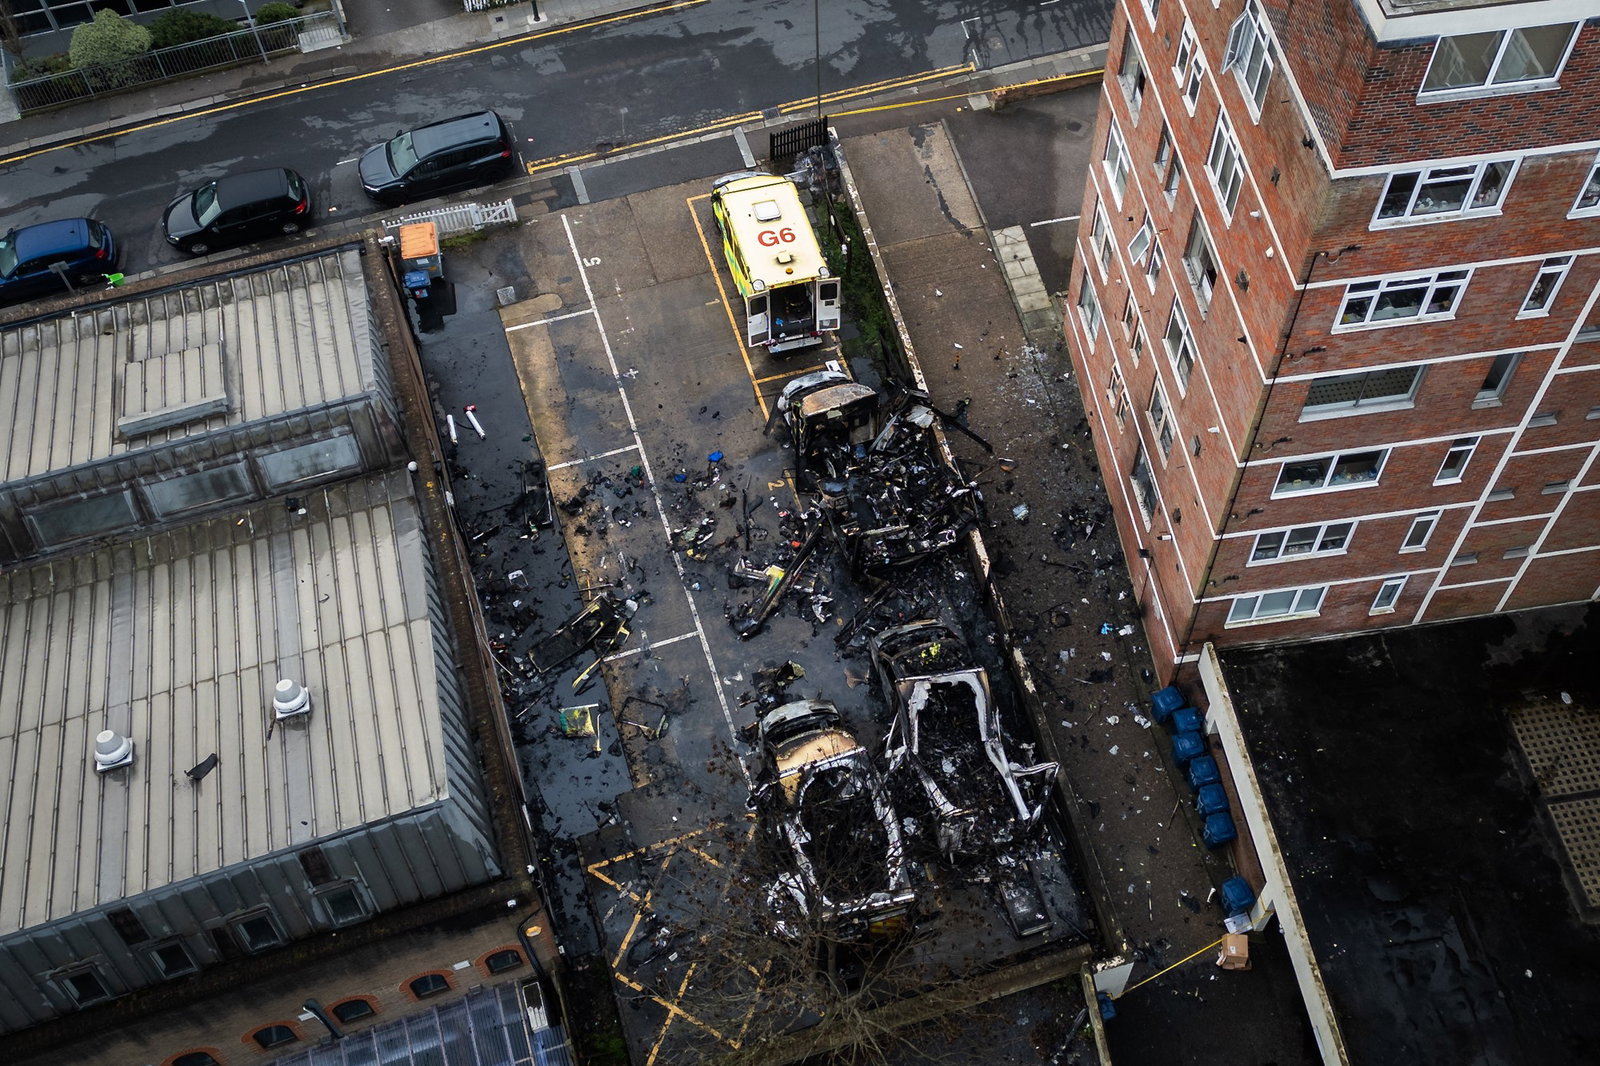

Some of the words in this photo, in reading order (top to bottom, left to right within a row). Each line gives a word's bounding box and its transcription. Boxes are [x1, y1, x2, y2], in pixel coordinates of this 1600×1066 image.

[757, 228, 796, 247] G6
[583, 257, 601, 267] 5
[768, 480, 785, 491] 2
